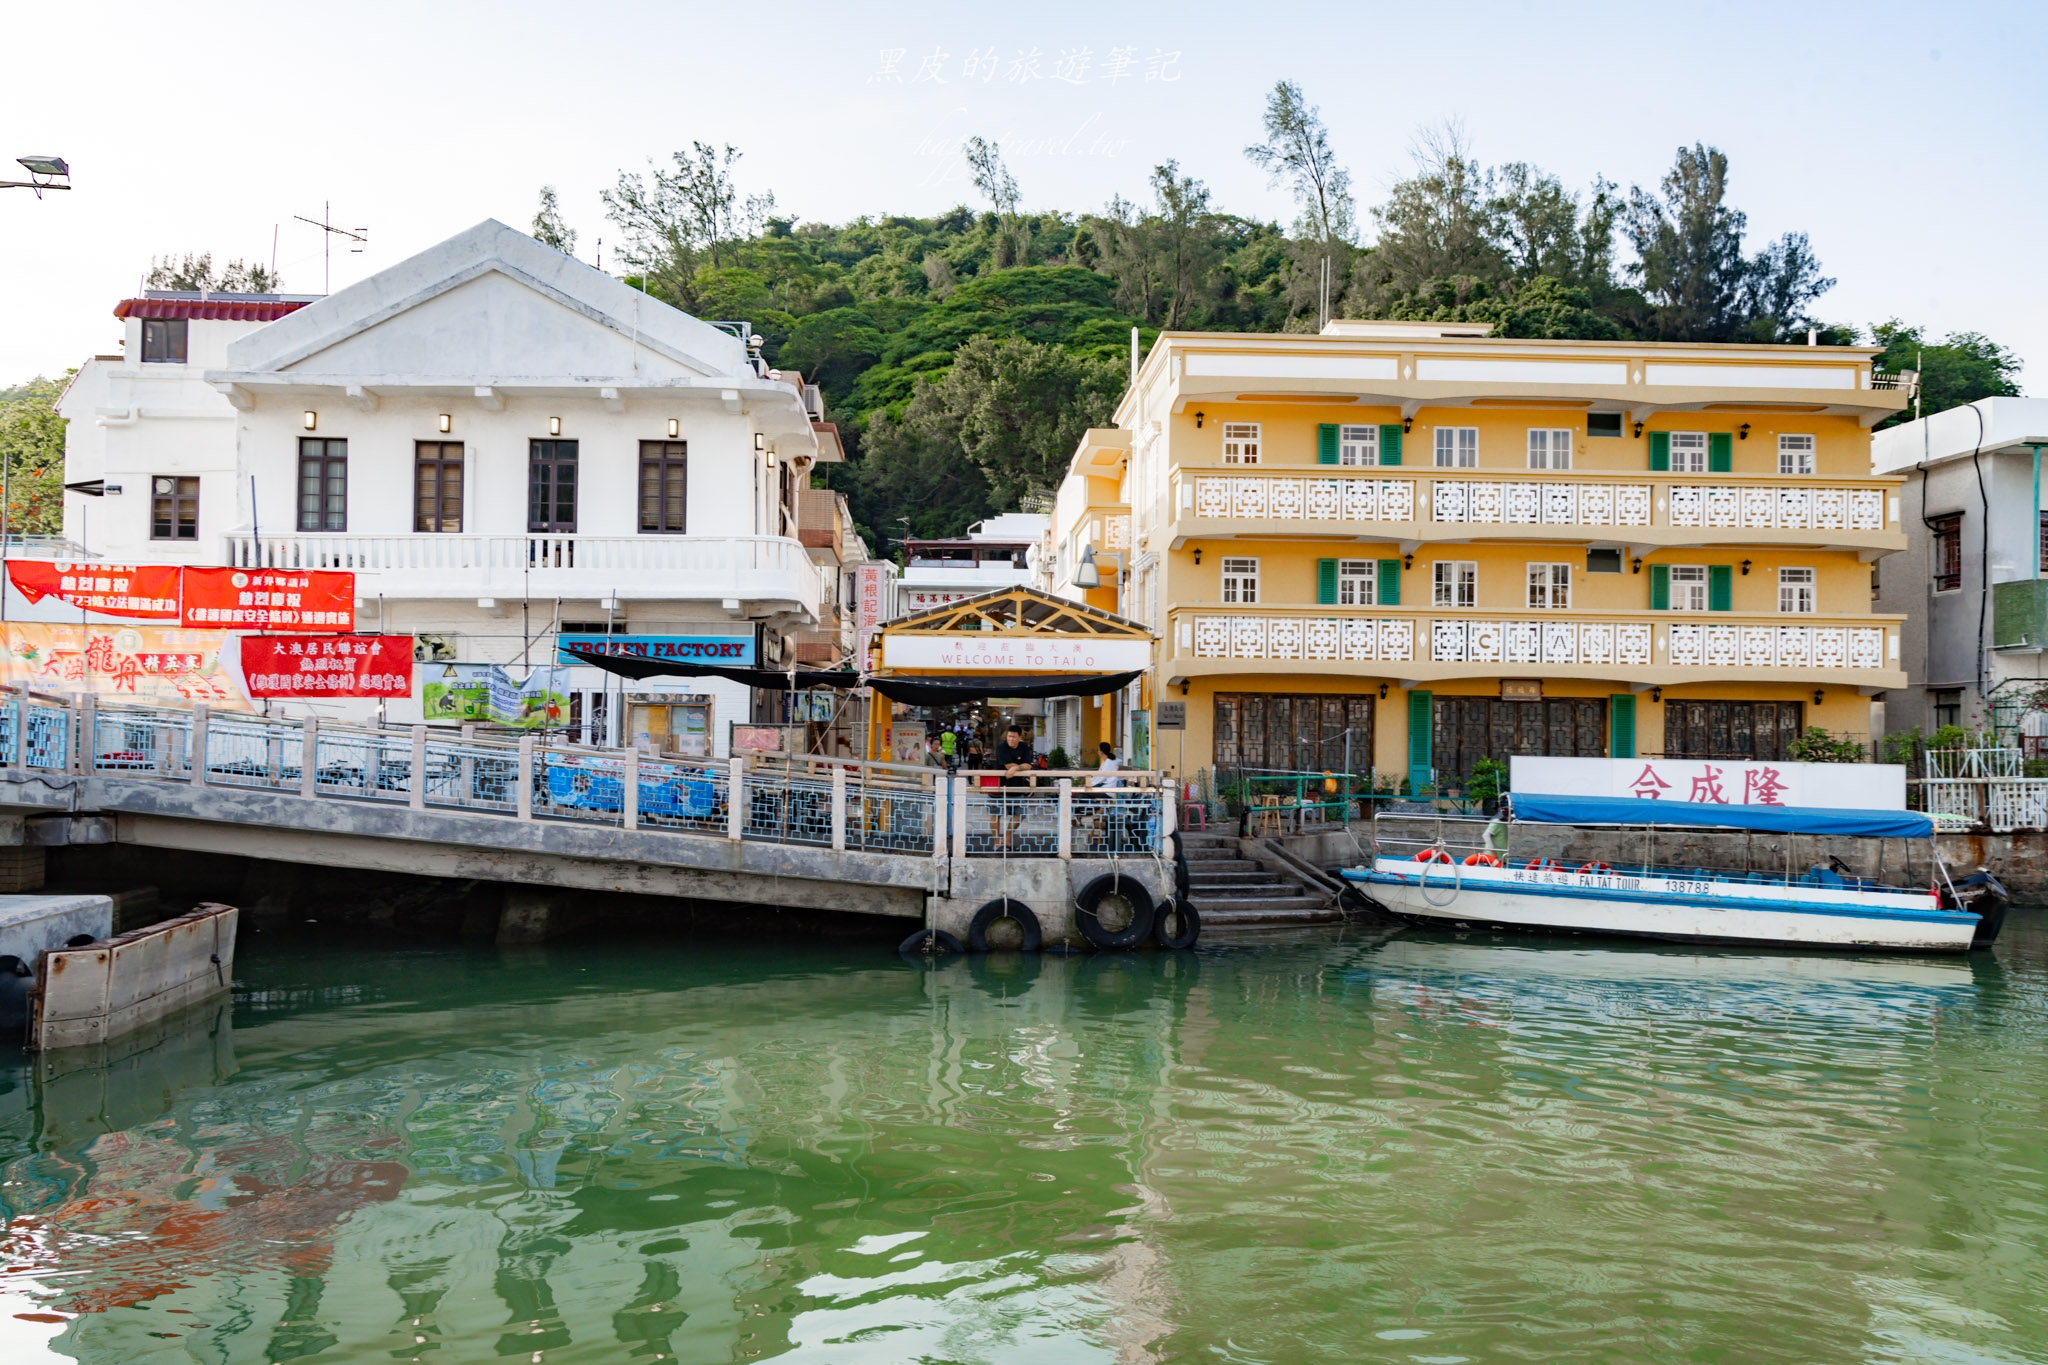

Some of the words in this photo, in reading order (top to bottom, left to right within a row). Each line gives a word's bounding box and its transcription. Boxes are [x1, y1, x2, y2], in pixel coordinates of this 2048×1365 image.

[239, 591, 302, 607] 熱烈慶祝
[272, 641, 384, 656] 大澳居民聯誼會
[568, 642, 652, 657] FROZEN
[653, 642, 745, 657] FACTORY
[942, 654, 1015, 665] WELCOME
[1026, 655, 1044, 666] TO
[1053, 656, 1077, 666] TAI
[1085, 656, 1095, 667] O
[1628, 763, 1790, 807] 合成隆
[1579, 875, 1594, 887] FAI
[1597, 876, 1612, 889] TAT
[1616, 877, 1640, 890] TOUR
[1665, 880, 1710, 894] 138788
